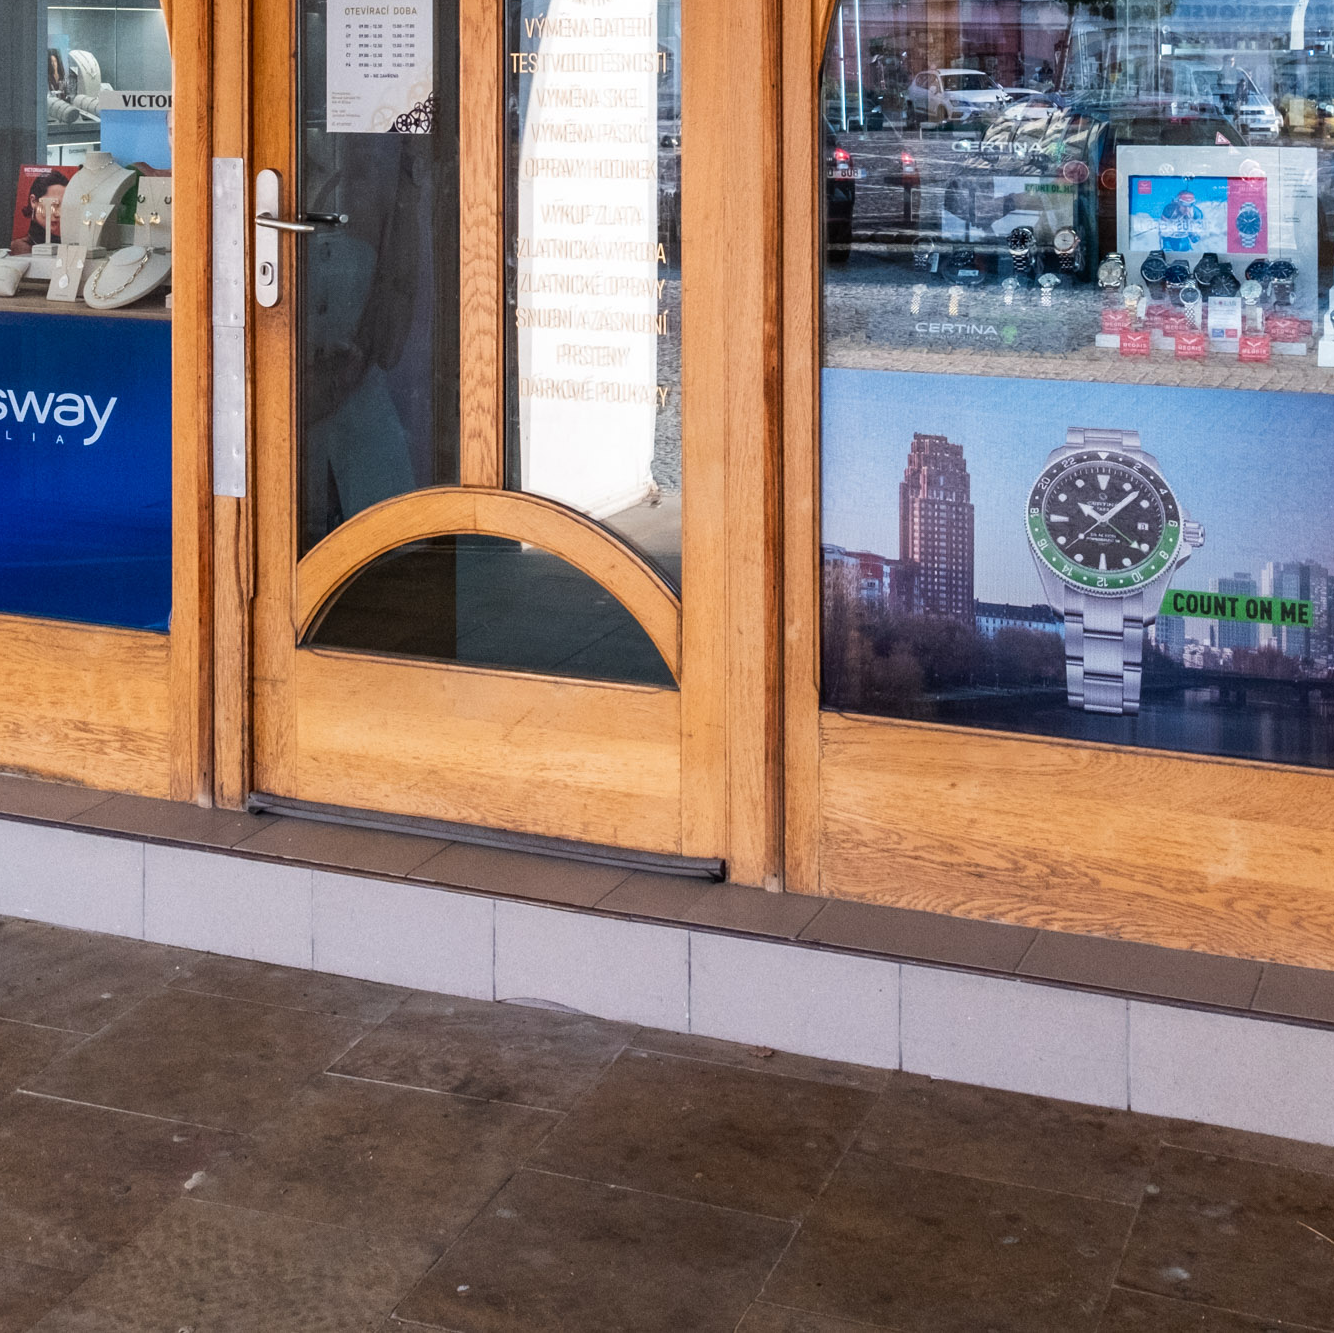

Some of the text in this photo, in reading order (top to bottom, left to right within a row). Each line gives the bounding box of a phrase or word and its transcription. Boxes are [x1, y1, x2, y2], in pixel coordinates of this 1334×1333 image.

[344, 5, 418, 16] OTEVÍRACÍ DOBA
[525, 12, 589, 38] VÝMĚNA
[510, 52, 547, 74] TEST
[951, 141, 1044, 153] CERTINA
[915, 322, 998, 335] CERTINA
[1062, 457, 1077, 468] 22
[1133, 463, 1142, 471] 2
[1038, 478, 1050, 489] 20
[1030, 507, 1039, 517] 18
[1038, 539, 1049, 551] 16
[1159, 550, 1169, 560] 8
[1062, 566, 1073, 576] 14
[1097, 576, 1108, 587] 12
[1131, 571, 1144, 583] 10
[1173, 593, 1308, 624] COUNT ON ME
